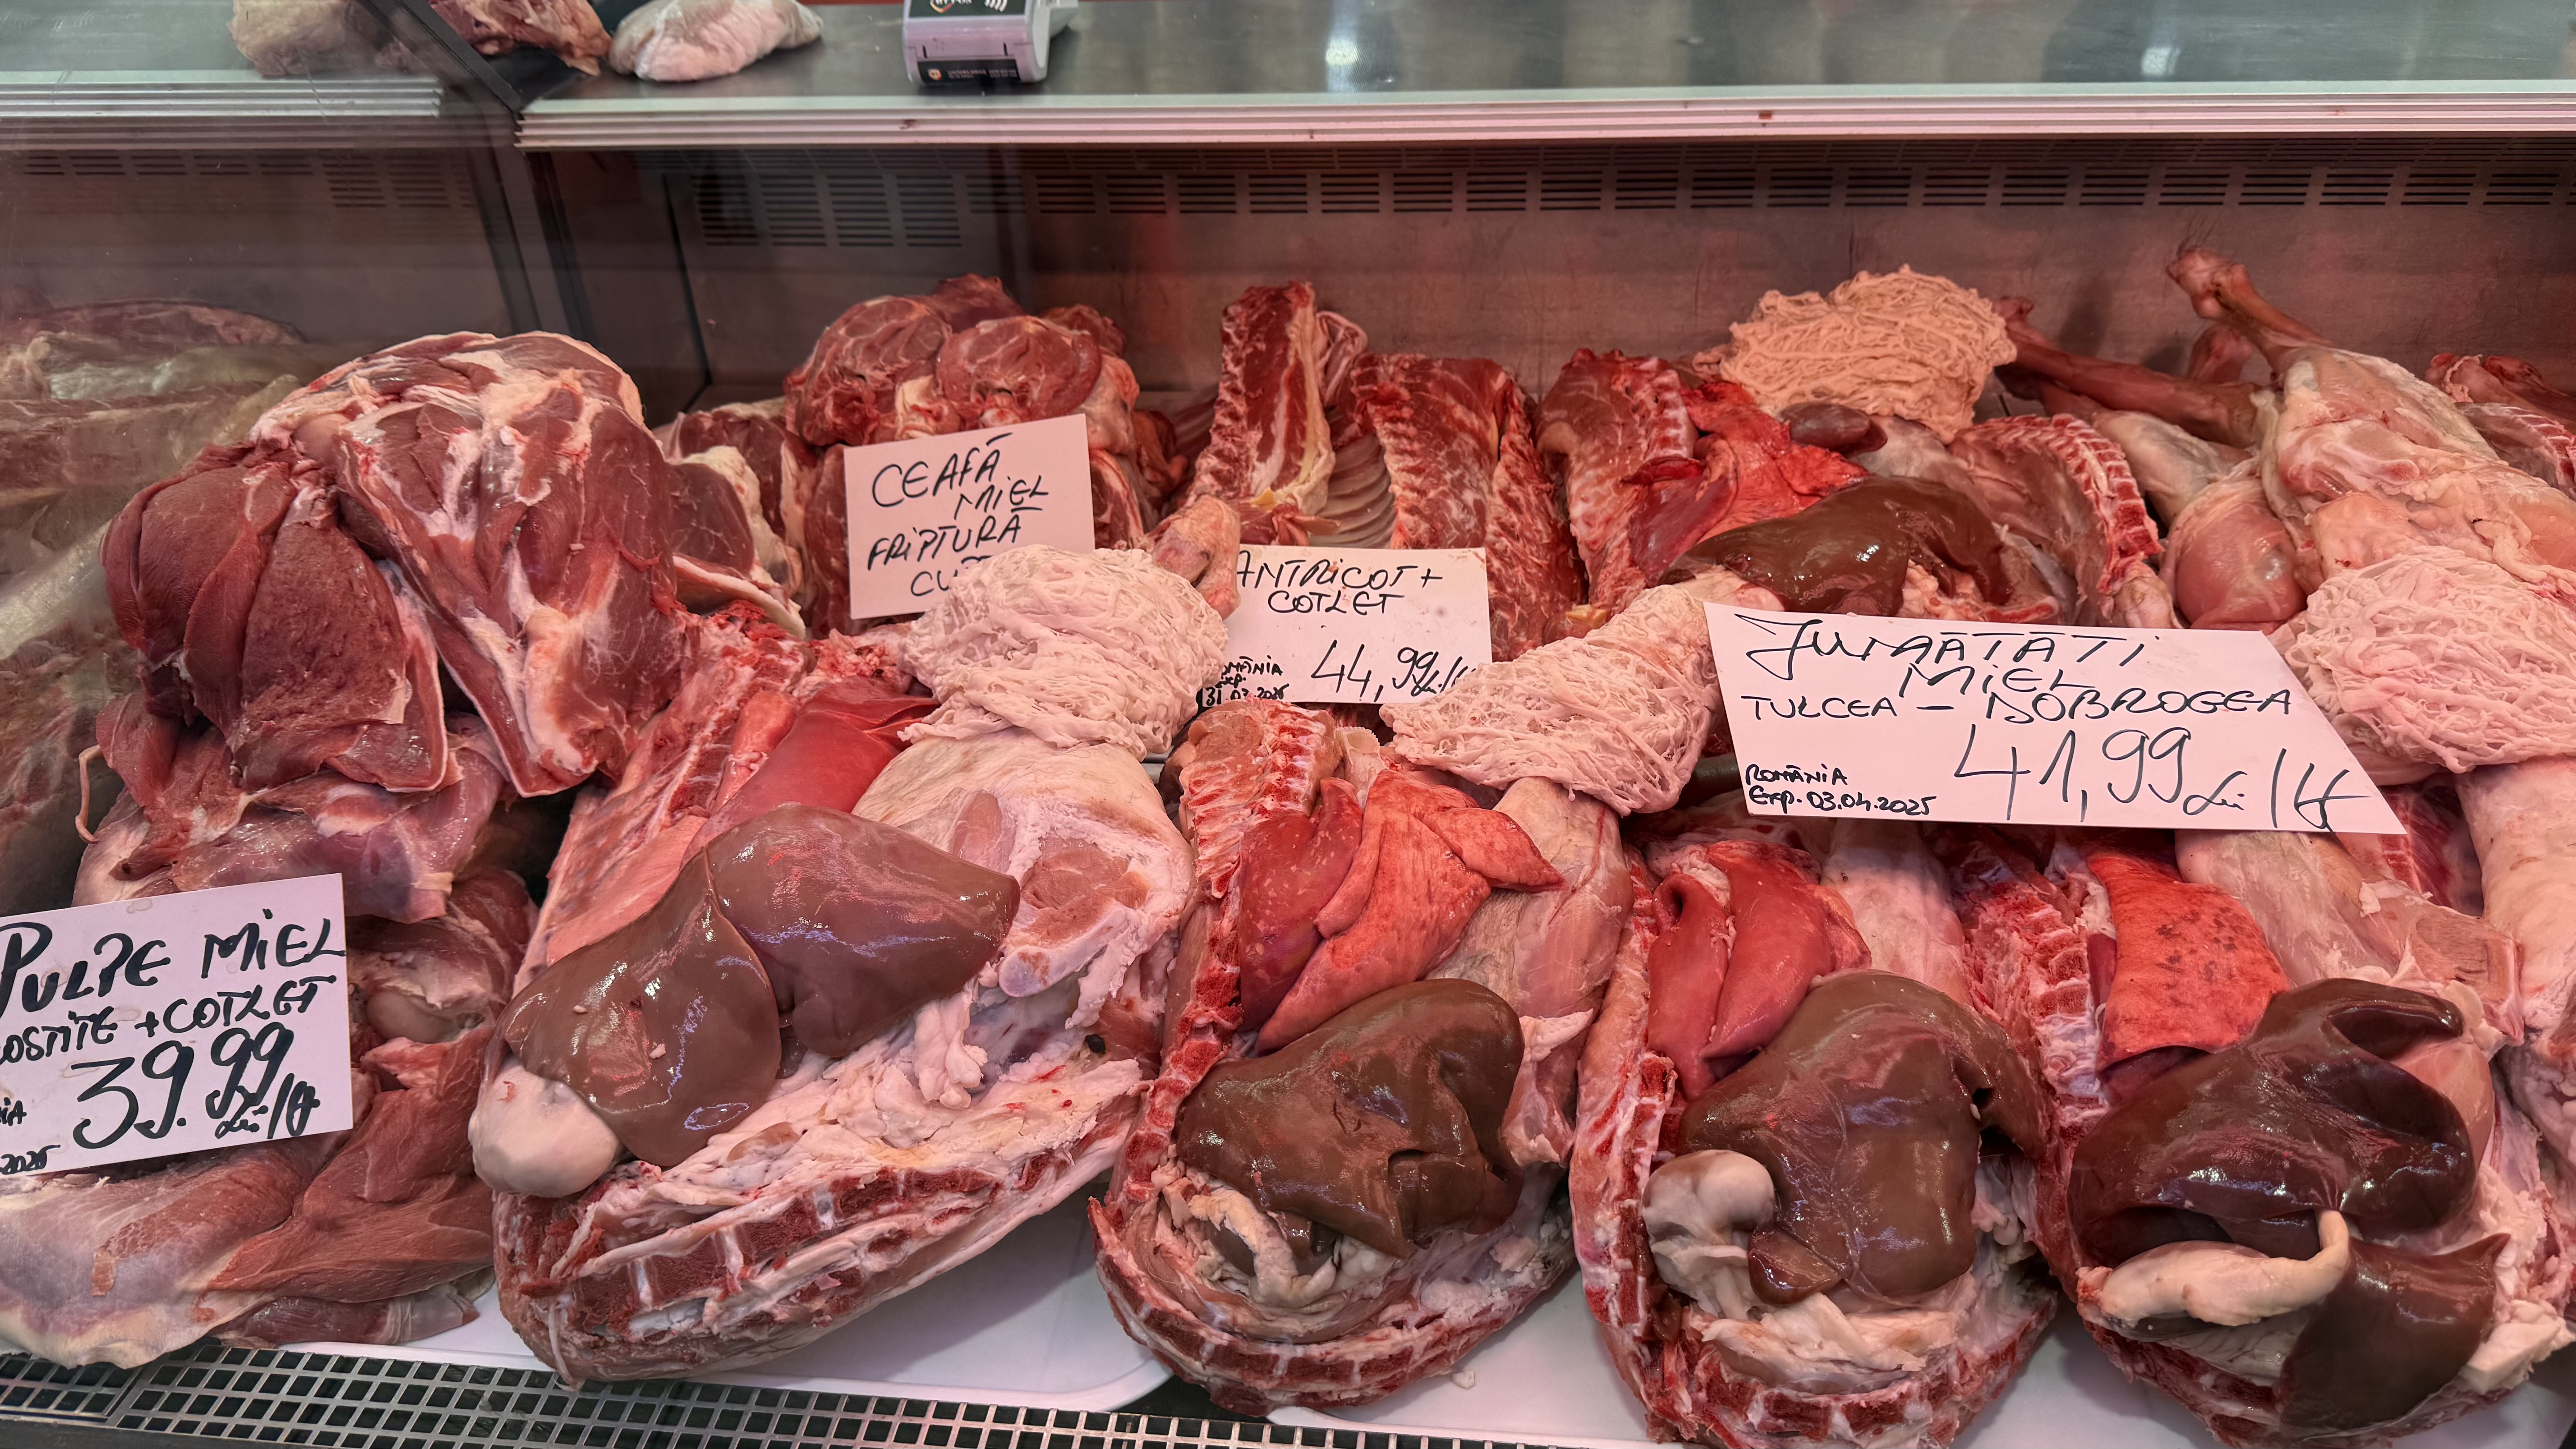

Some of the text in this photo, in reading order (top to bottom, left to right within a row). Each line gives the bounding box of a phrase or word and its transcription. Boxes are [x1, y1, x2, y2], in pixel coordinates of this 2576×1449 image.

[1268, 590, 1405, 616] COTLET
[1741, 696, 1898, 721] TULCEA
[1954, 723, 2192, 823] 41,99
[1806, 791, 1937, 816] 03.04.2025
[0, 921, 171, 1019] PULPE
[0, 1006, 119, 1065] OSTITE
[70, 1021, 294, 1150] 39.99
